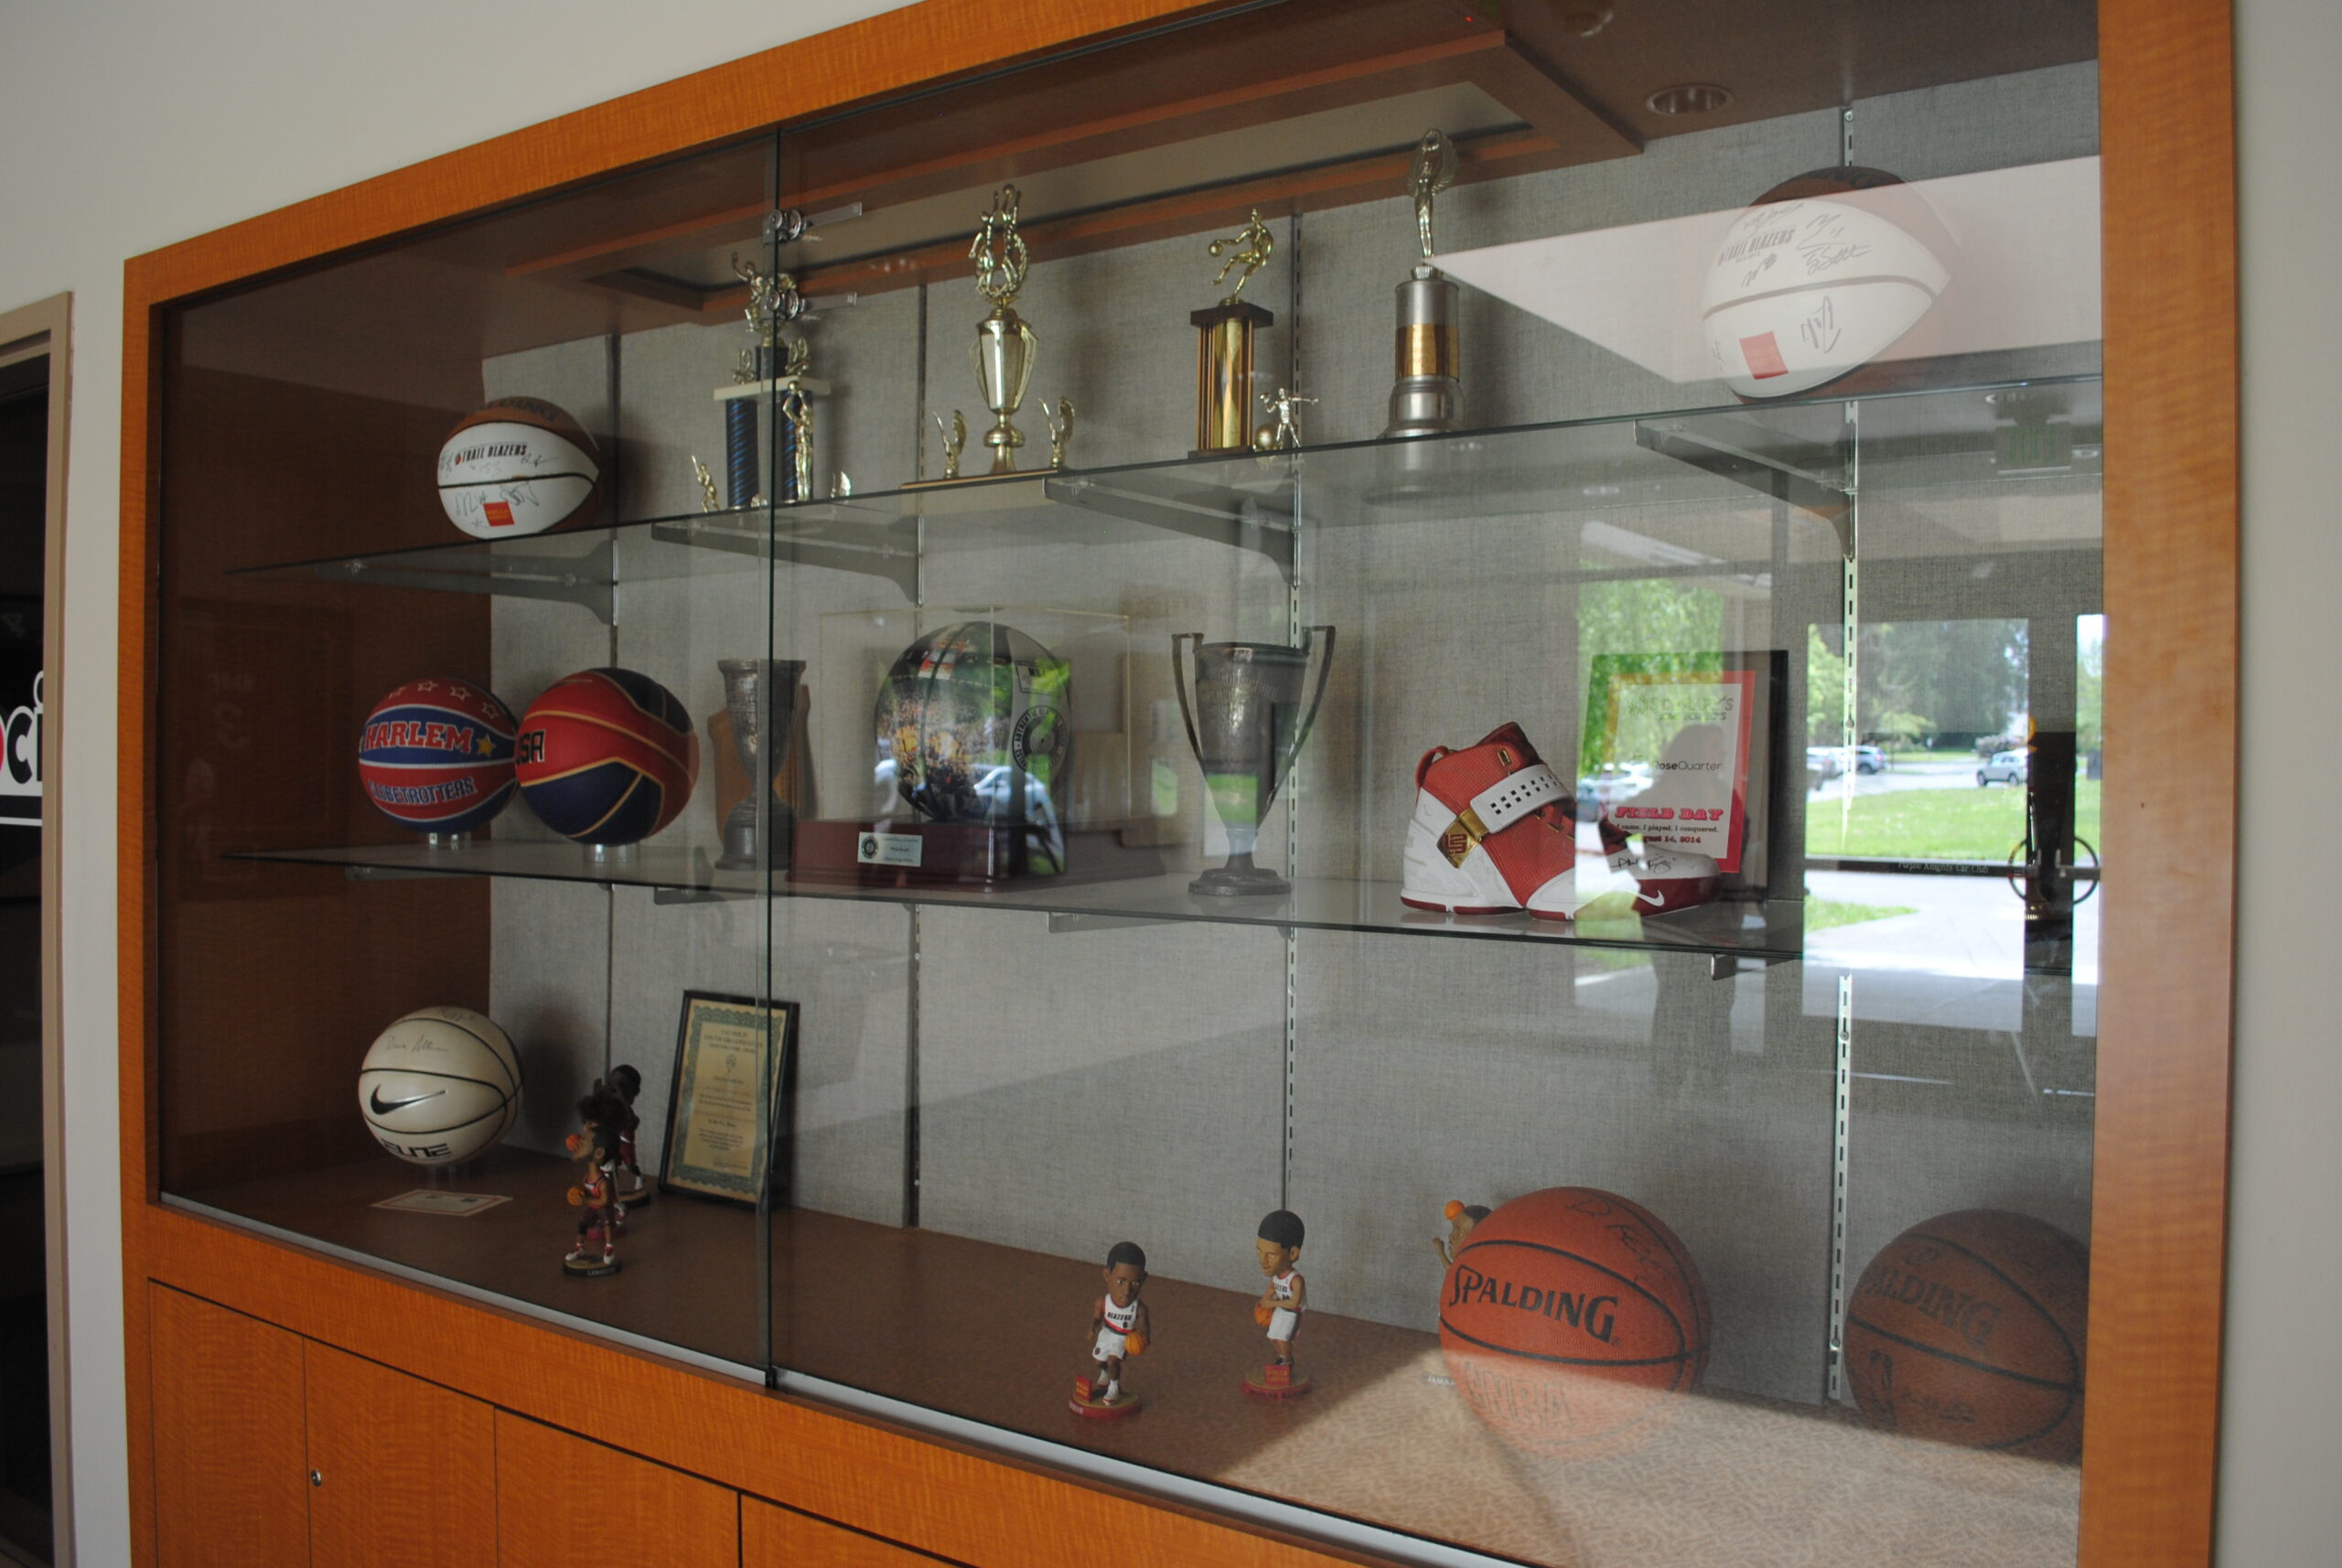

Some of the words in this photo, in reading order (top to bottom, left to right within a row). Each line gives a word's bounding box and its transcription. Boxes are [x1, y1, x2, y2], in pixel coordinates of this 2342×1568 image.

[462, 446, 485, 463] TRAIL
[488, 444, 528, 458] BLAZERS
[364, 720, 474, 755] HARLEM
[517, 729, 547, 765] SA
[1615, 806, 1675, 820] FIELD
[1678, 808, 1724, 821] DAY
[1648, 824, 1673, 832] played.
[1924, 863, 1953, 873] Knights
[1956, 864, 1968, 873] Car
[1971, 864, 1989, 874] Club
[381, 1137, 453, 1159] ELITE
[1448, 1263, 1619, 1344] SPALDING
[1858, 1264, 2003, 1350] ALDING
